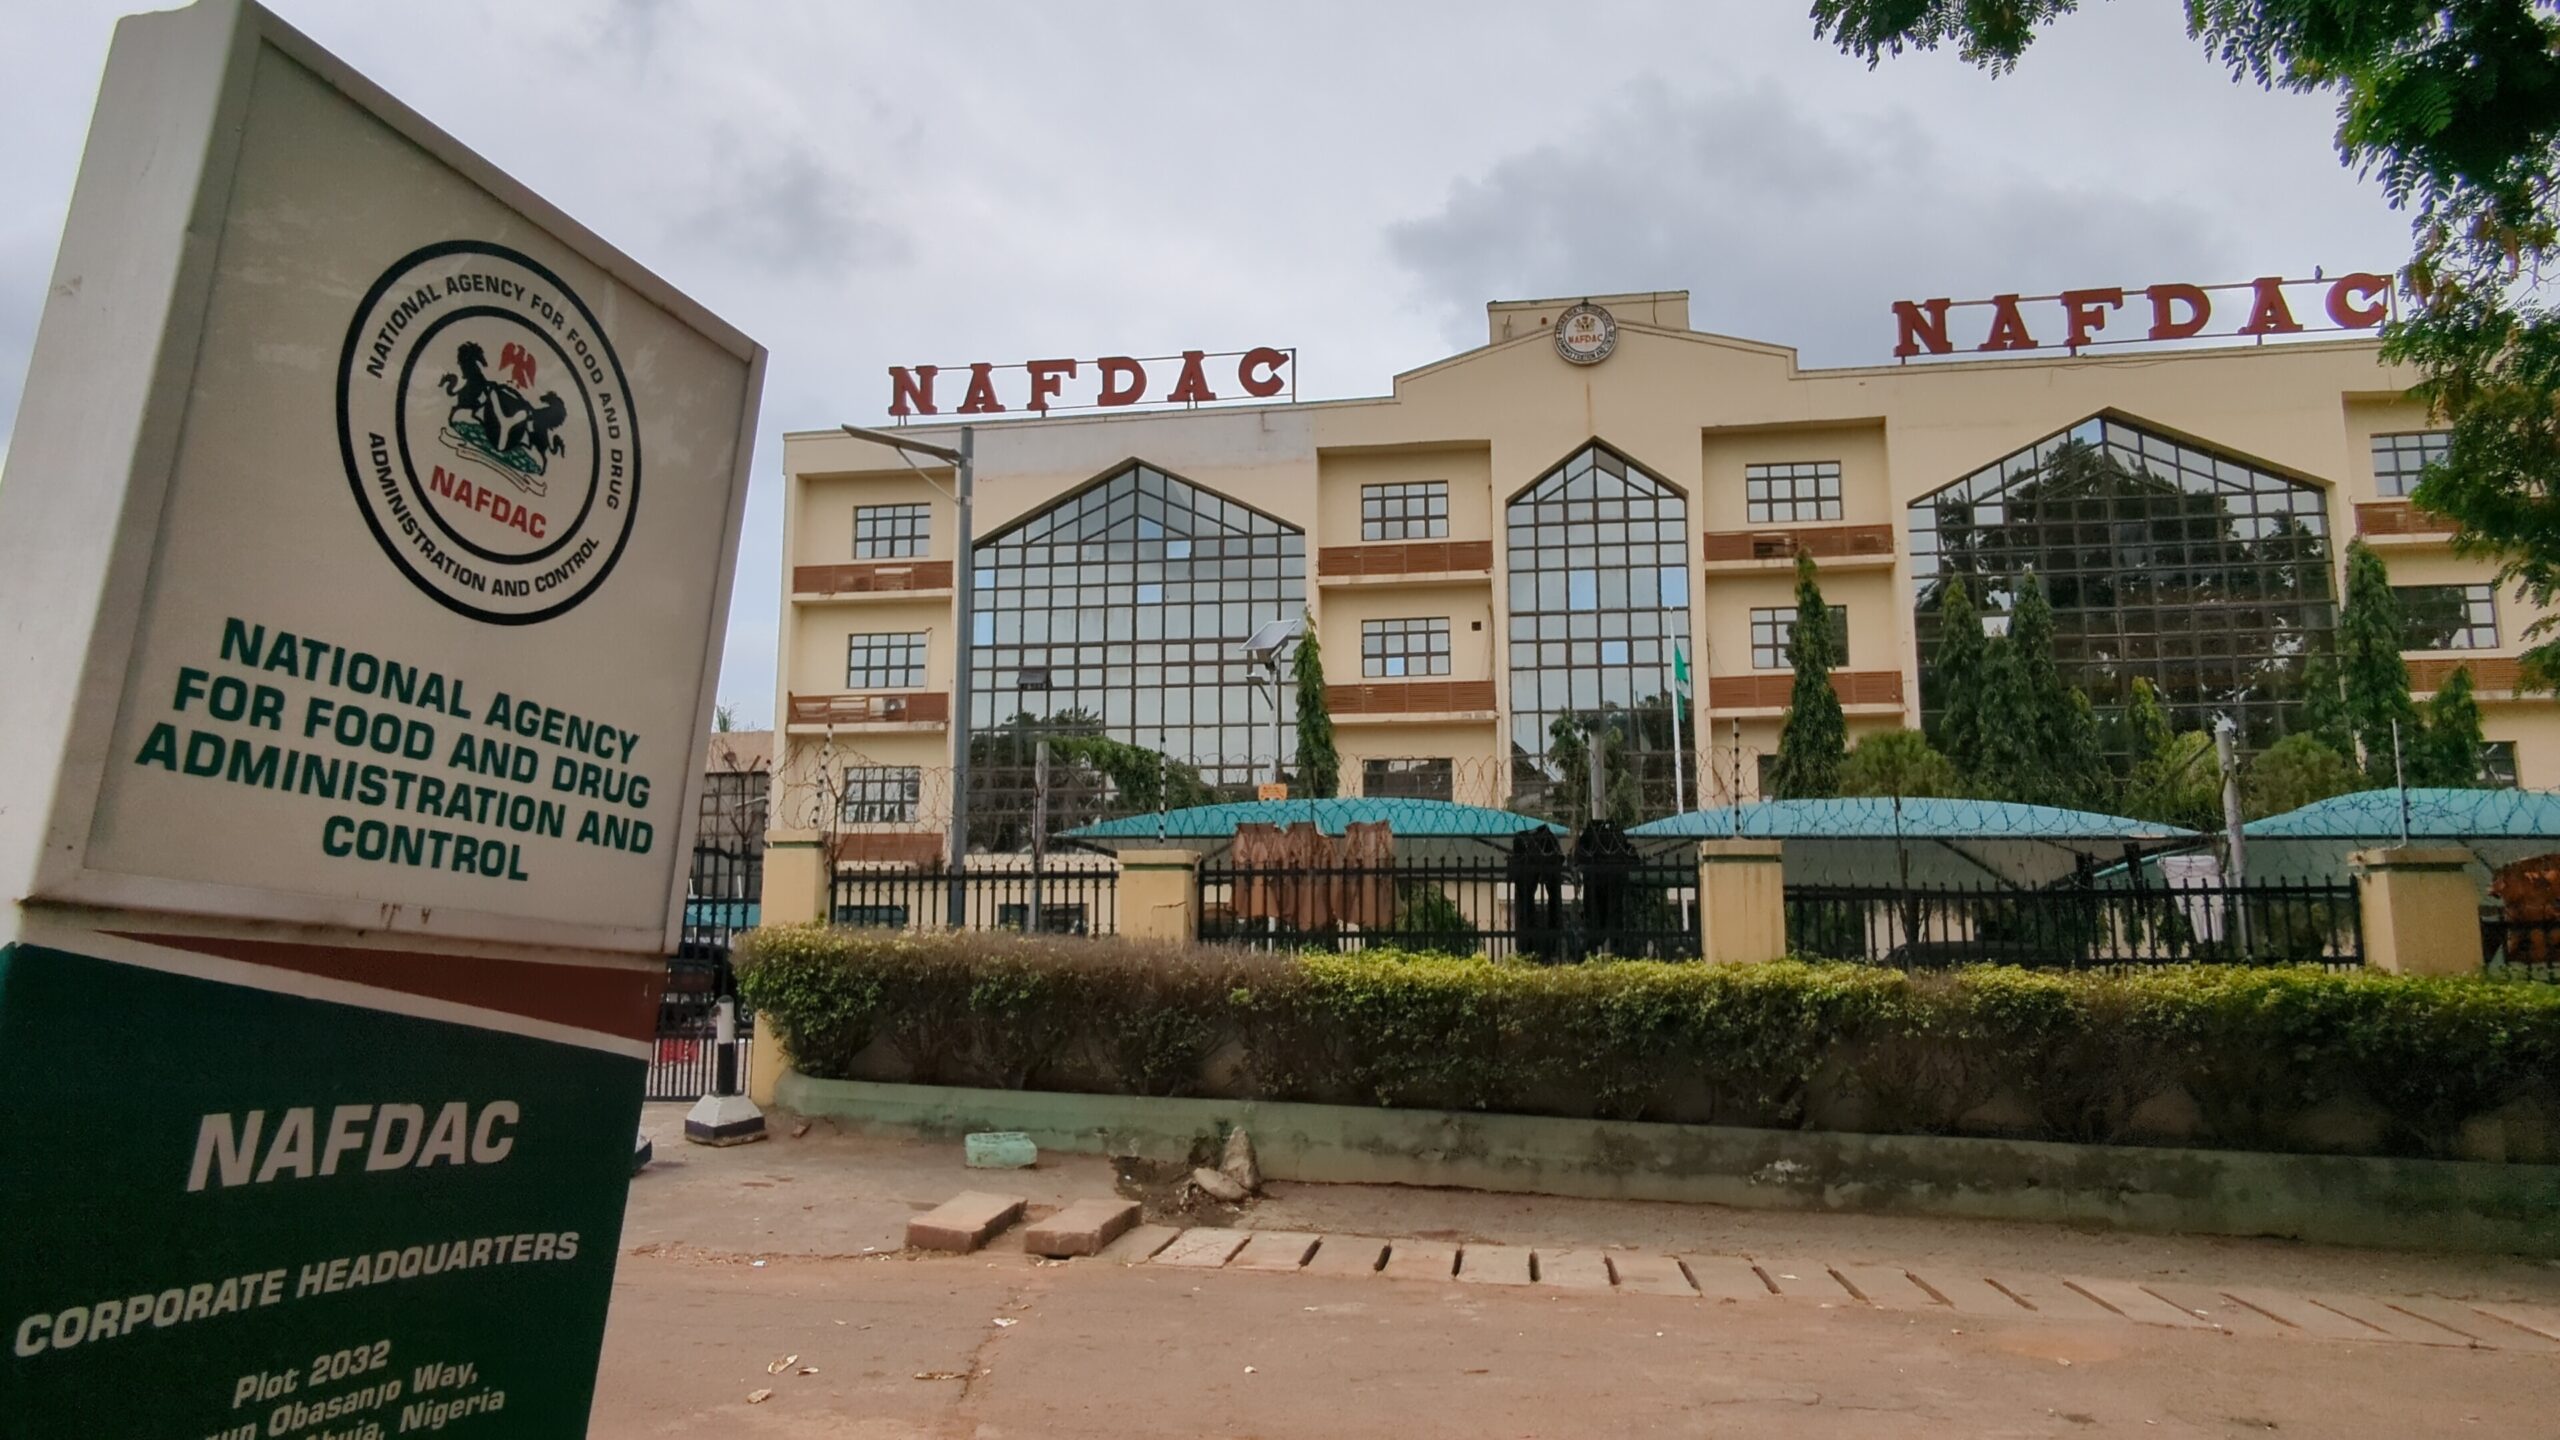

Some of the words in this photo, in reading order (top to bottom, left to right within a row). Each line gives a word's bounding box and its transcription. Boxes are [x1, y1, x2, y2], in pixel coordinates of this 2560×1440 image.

[445, 274, 526, 303] AGENCY
[530, 294, 565, 331] FOR
[1891, 272, 2391, 357] NAFDAC
[366, 282, 442, 379] NATIONAL
[566, 328, 604, 385] FOOD
[1567, 334, 1604, 344] NAFDAC
[599, 391, 620, 440] AND
[888, 346, 1290, 416] NAFDAC
[368, 431, 486, 593] ADMINISTRATION
[491, 578, 531, 597] AND
[534, 536, 600, 593] CONTROL
[429, 465, 547, 539] NAFDAC
[605, 449, 624, 511] DRUG
[219, 617, 472, 721] NATIONAL
[484, 692, 640, 764] AGENCY
[172, 666, 286, 731] FOR
[303, 697, 435, 761] FOOD
[448, 732, 539, 785] AND
[551, 756, 651, 809] DRUG
[134, 721, 565, 839] ADMINISTRATION
[576, 811, 654, 856] AND
[322, 815, 529, 882] CONTROL
[186, 1100, 520, 1193] NAFDAC
[14, 1268, 288, 1358] CORPORATE
[296, 1231, 580, 1299] HEADQUARTERS
[232, 1367, 300, 1409] Plot
[308, 1339, 391, 1387] 2032
[268, 1379, 402, 1437] Obasanjo
[413, 1361, 478, 1395] Way,
[400, 1387, 505, 1433] Nigeria
